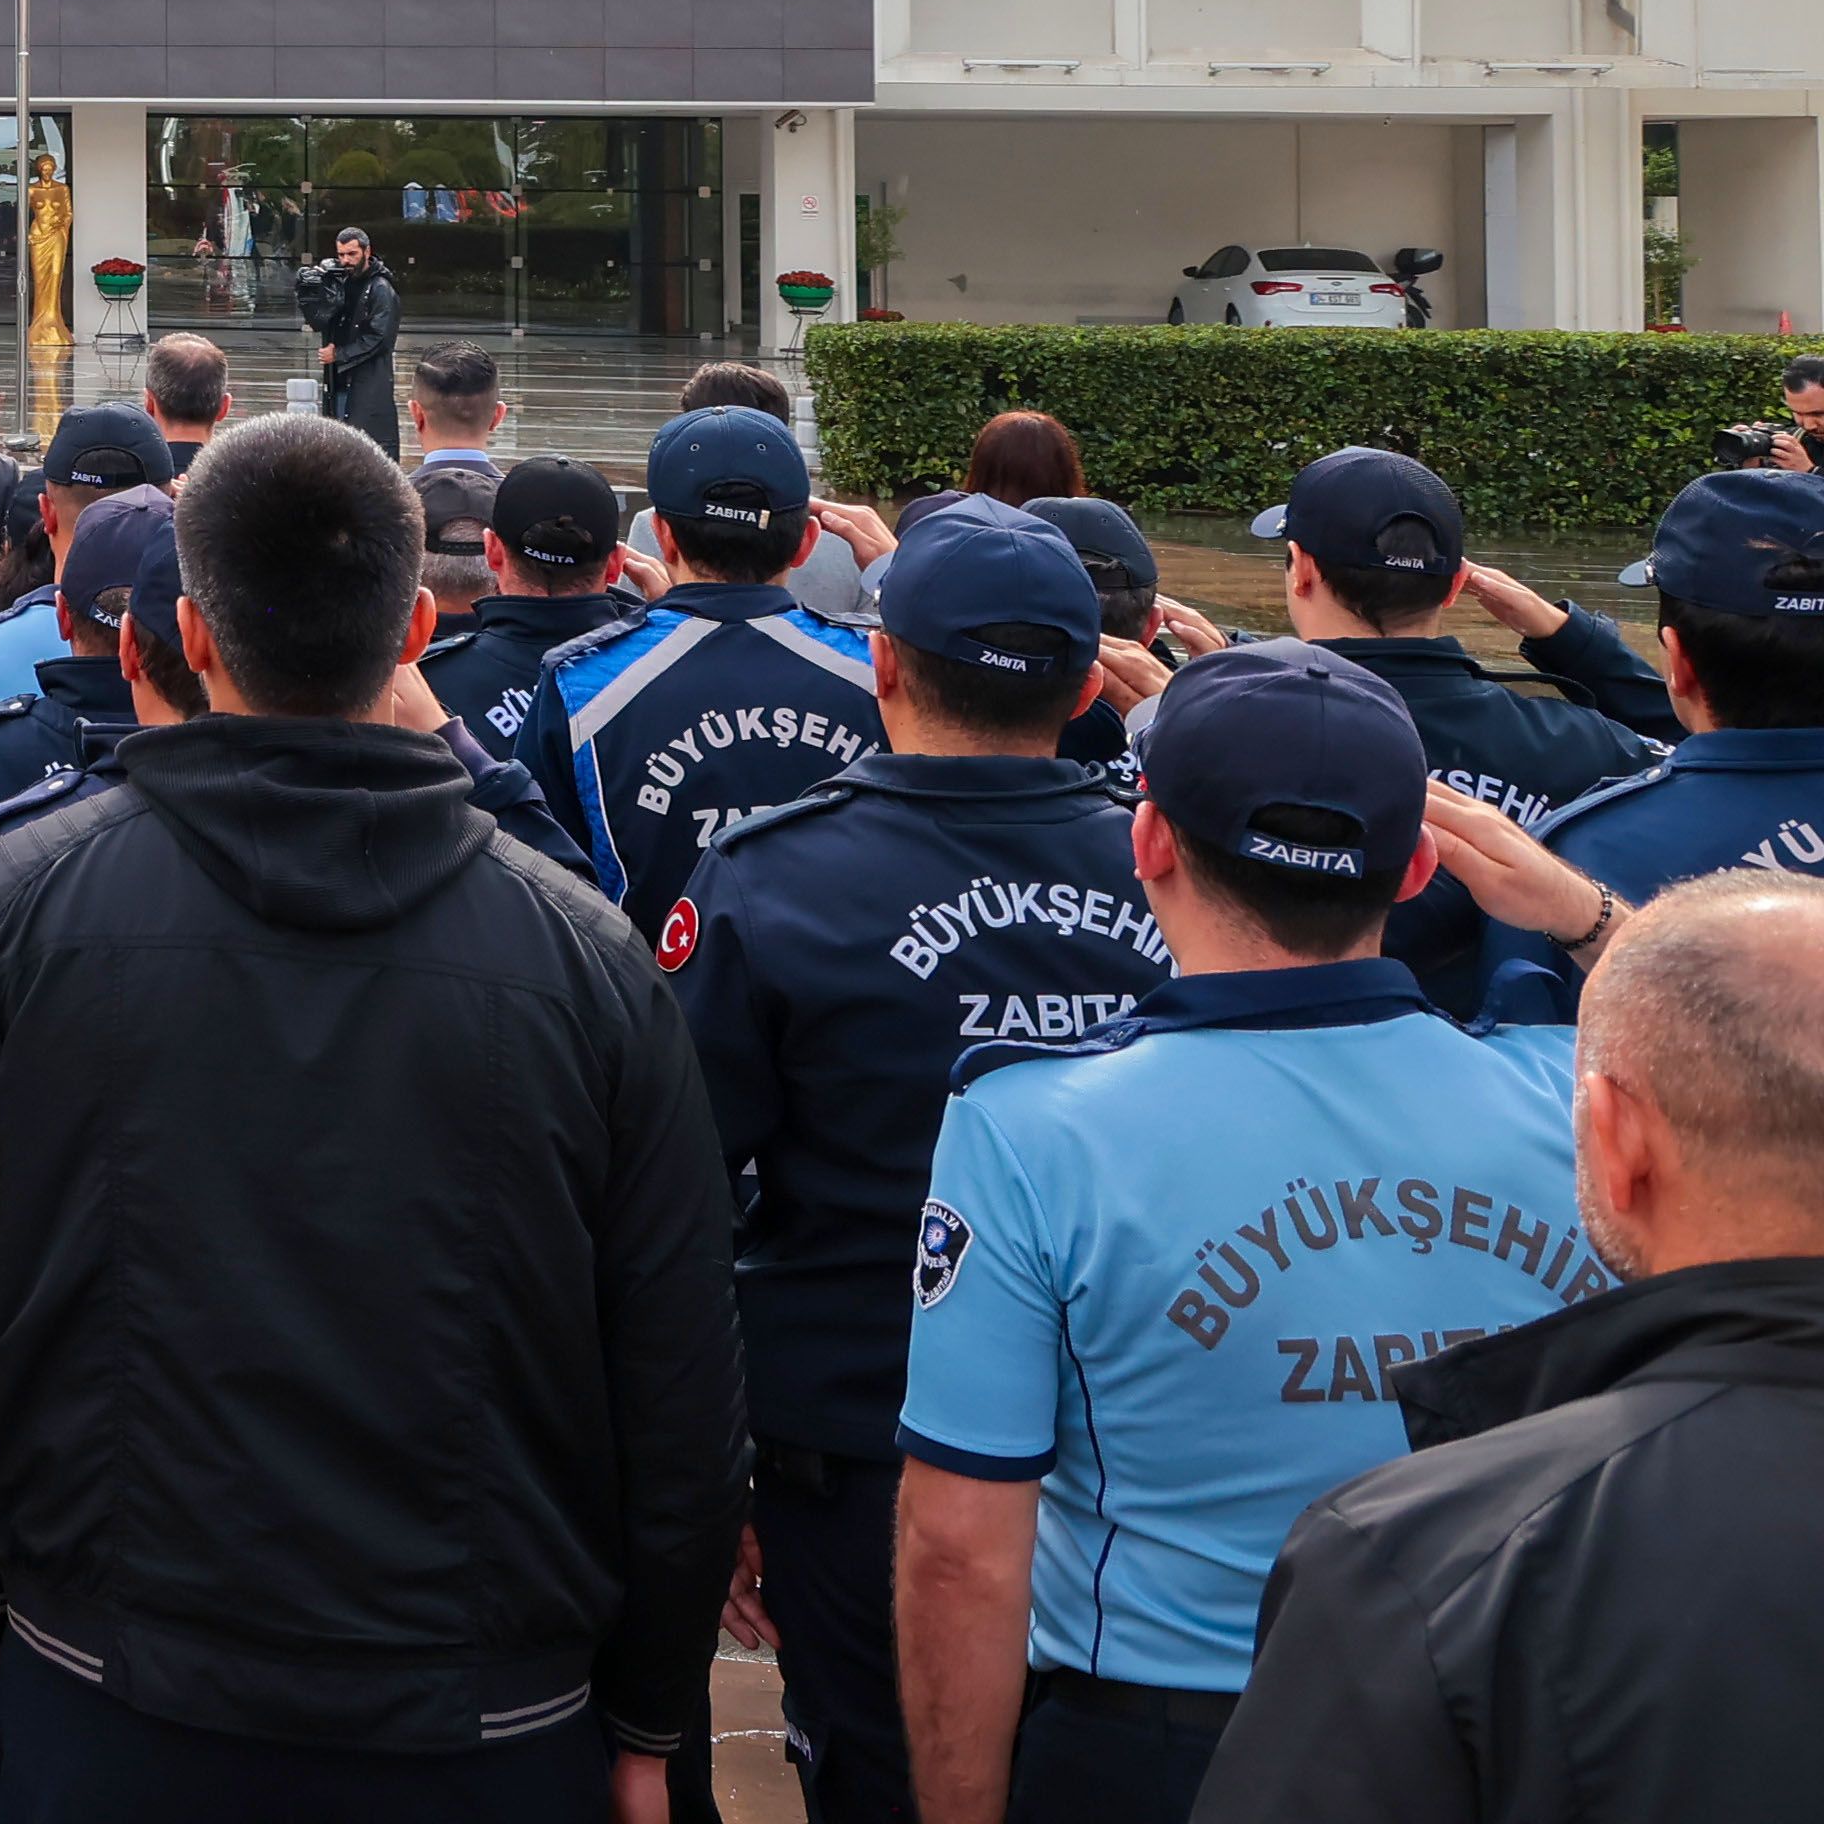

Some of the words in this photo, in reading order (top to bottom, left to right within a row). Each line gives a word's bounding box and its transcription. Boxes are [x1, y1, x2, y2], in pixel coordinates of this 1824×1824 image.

[71, 472, 103, 485] ZABITA
[705, 504, 757, 523] ZABITA
[523, 546, 575, 565] ZABITA
[1385, 554, 1425, 569] ZABITA
[1774, 596, 1824, 611] ZABIT
[980, 650, 1028, 672] ZABITA
[1248, 835, 1358, 875] ZABITA
[1166, 1177, 1612, 1352] BÜYÜKŞEHİR
[1276, 1325, 1517, 1403] ZAB
